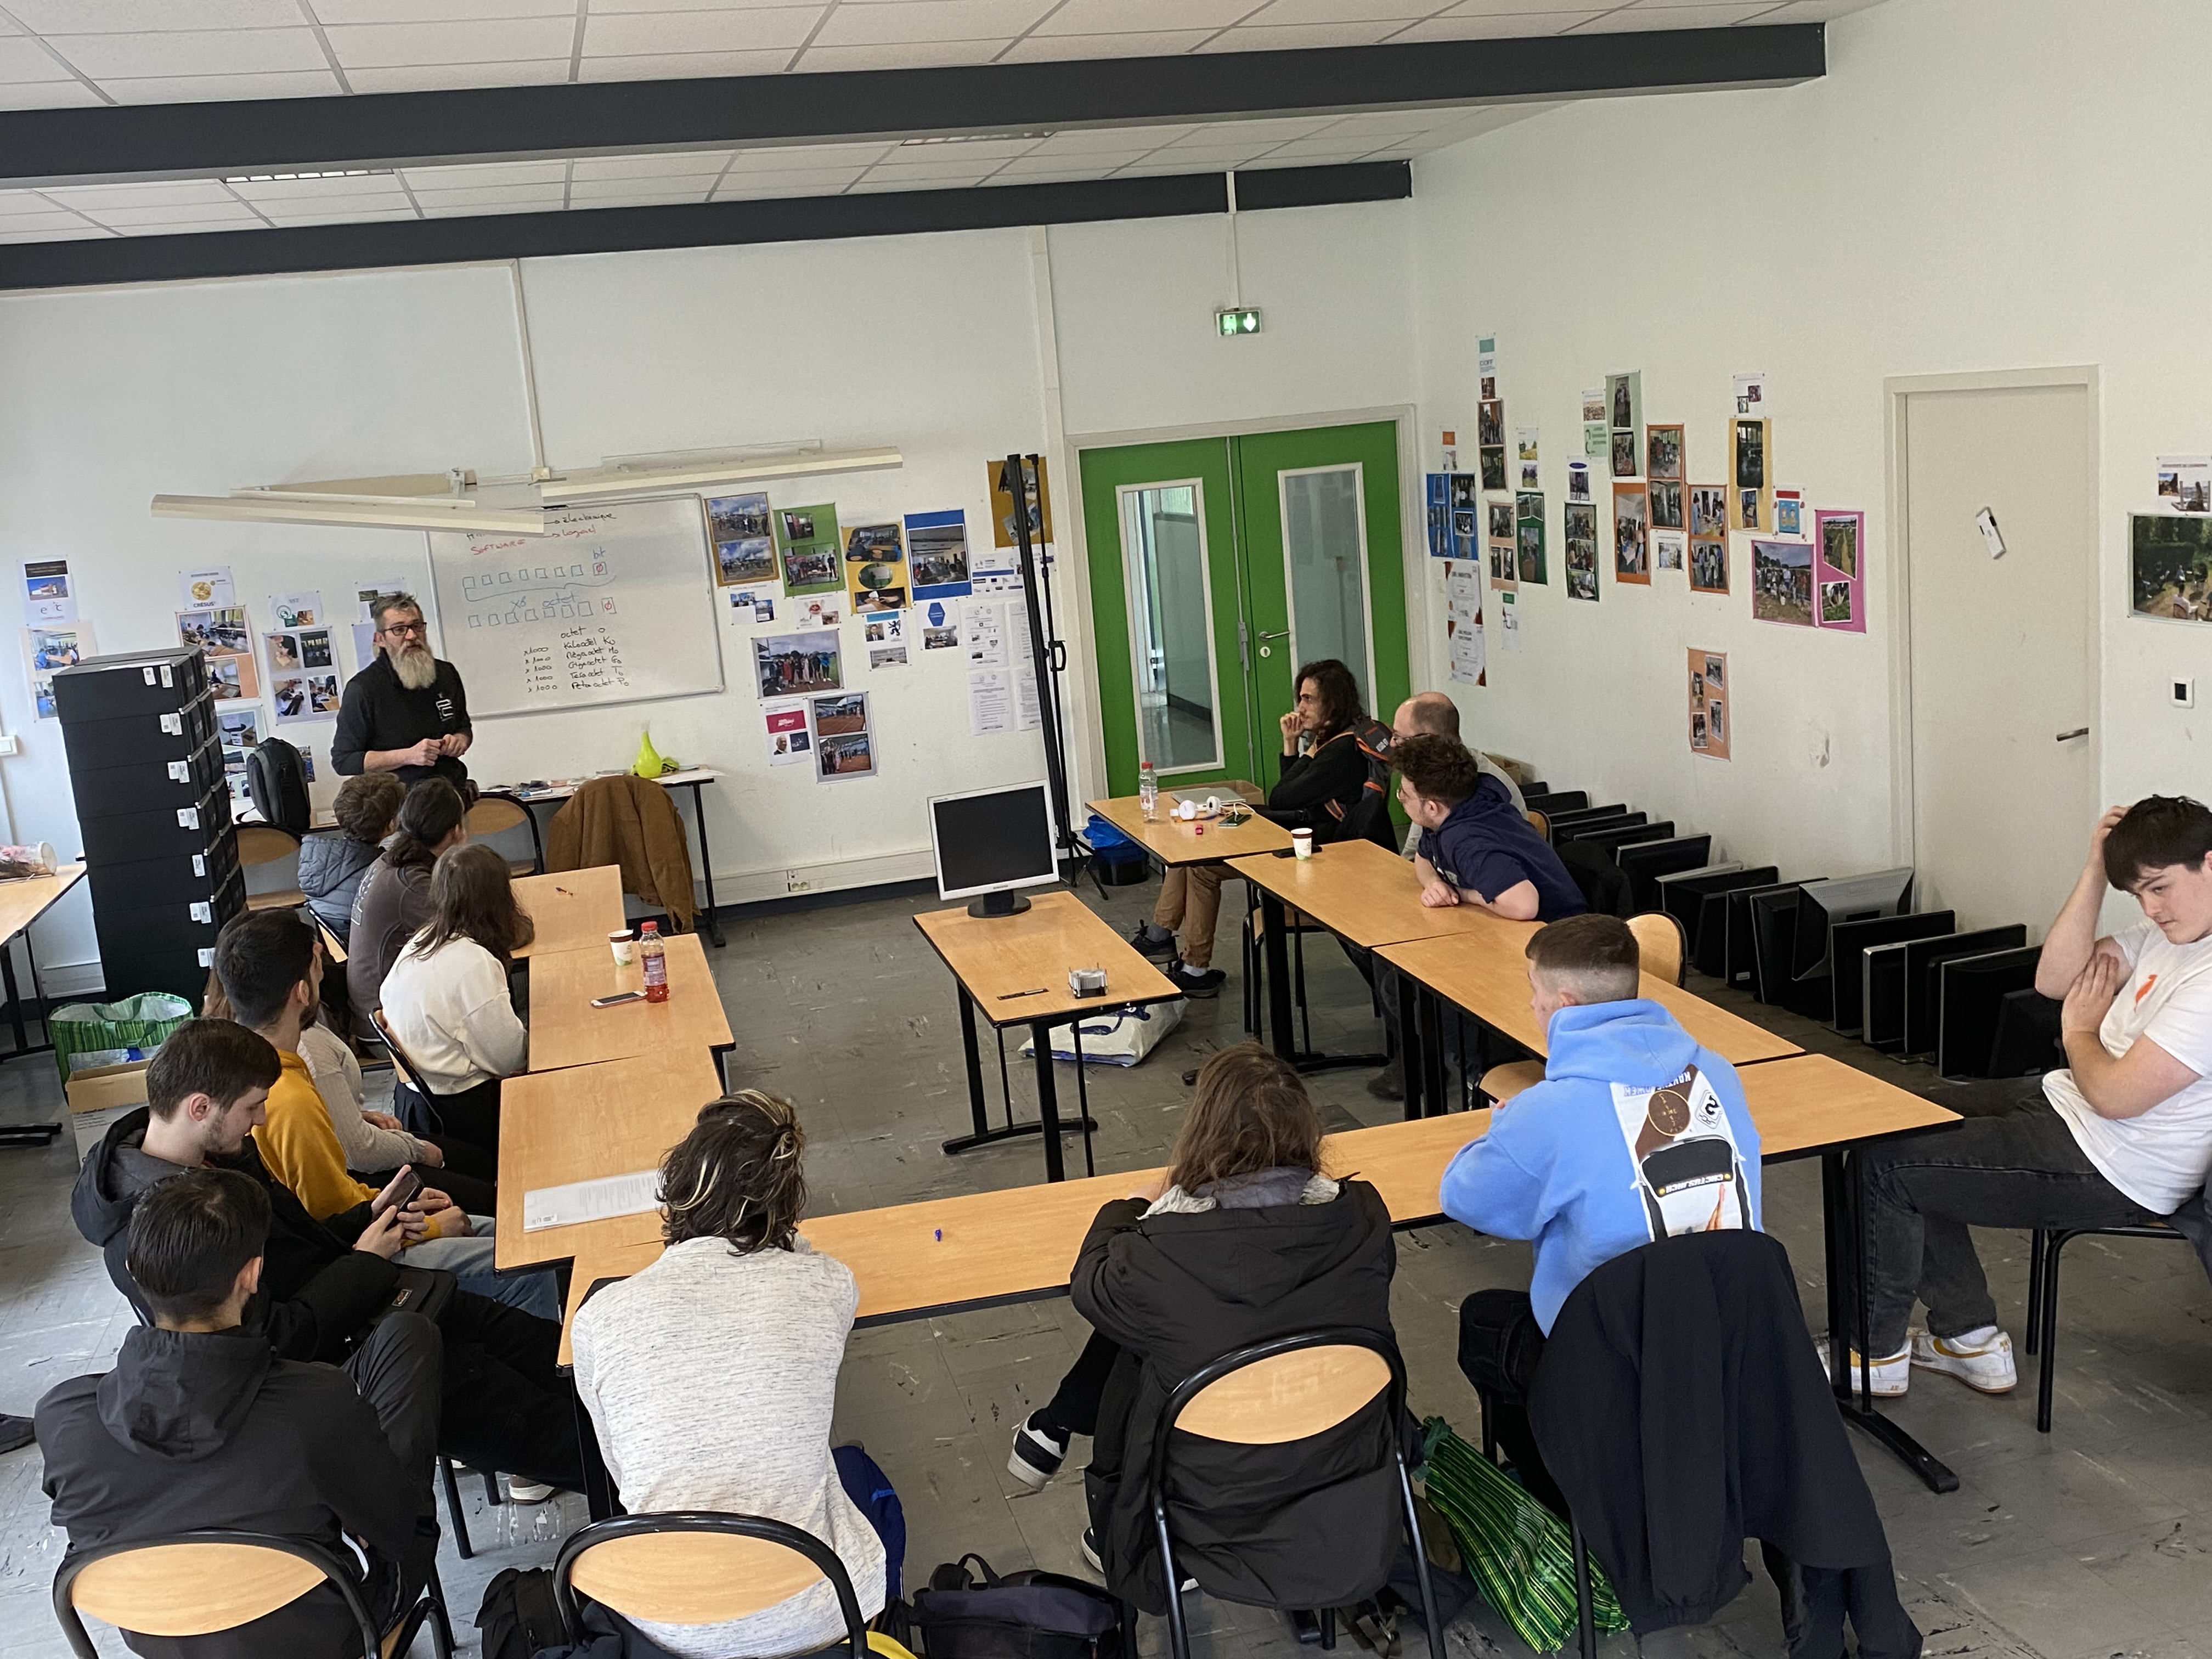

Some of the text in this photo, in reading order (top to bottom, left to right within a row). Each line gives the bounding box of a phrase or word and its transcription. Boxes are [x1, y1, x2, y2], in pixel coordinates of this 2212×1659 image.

[593, 546, 606, 559] bit
[543, 591, 579, 607] octet
[561, 626, 586, 639] octet
